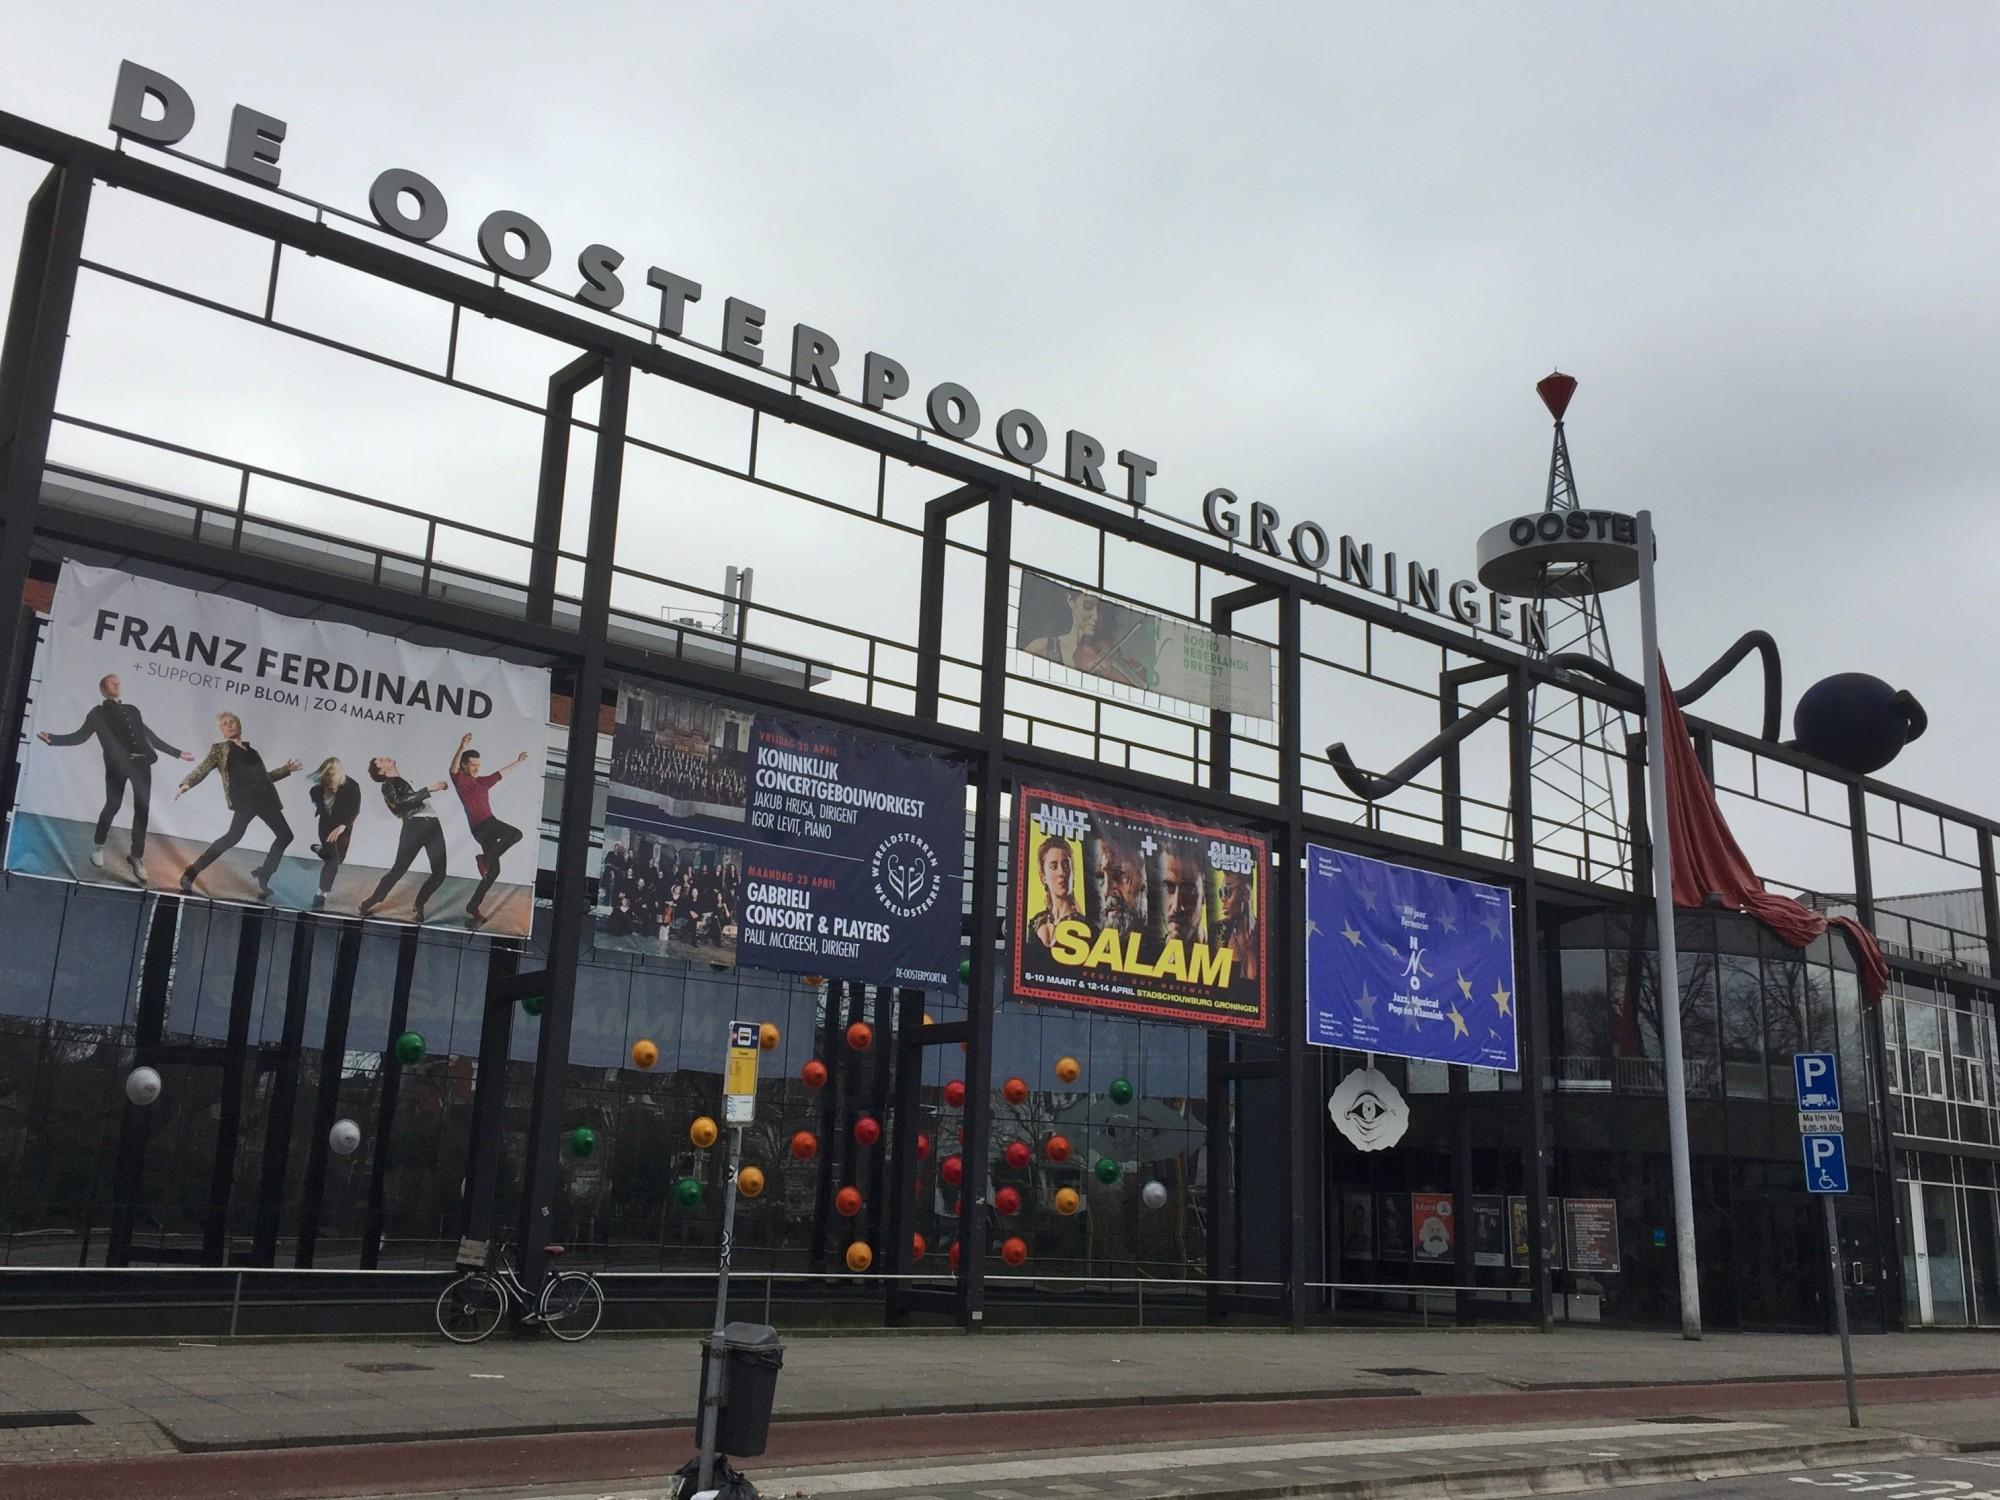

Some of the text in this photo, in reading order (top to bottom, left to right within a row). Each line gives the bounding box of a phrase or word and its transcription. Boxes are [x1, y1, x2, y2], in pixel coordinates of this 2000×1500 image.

[108, 58, 1550, 651] DE OOSTERPOORT GRONINGEN
[1184, 632, 1219, 652] NOORD
[92, 609, 493, 720] FRANZ FERDINAND
[1184, 647, 1249, 672] NEDERLANDS
[1184, 659, 1223, 677] ORKEST
[147, 661, 222, 690] SUPPORT
[224, 680, 250, 694] PIP
[254, 686, 299, 707] BLOM
[313, 697, 337, 713] ZO
[340, 702, 349, 716] 4
[349, 703, 406, 725] MAART
[757, 747, 839, 781] KONINKLIJK
[813, 743, 839, 758] APRIL
[753, 791, 858, 825] JAKUB HRUSA, DIRIGENT
[755, 769, 925, 818] CONCERTGEBOUWORKEST
[751, 810, 832, 840] IGOR LEVIT, PIANO
[1033, 803, 1091, 841] NNT
[872, 833, 938, 877] WERELDSTERREN
[748, 866, 793, 882] MAANDAG
[811, 876, 836, 890] APRIL
[747, 882, 810, 910] GABRIELI
[874, 875, 941, 917] WERELDSTERREN
[746, 904, 890, 943] CONSORT & PLAYERS
[744, 927, 860, 959] PAUL MCCREESH, DIRIGENT
[1050, 919, 1234, 988] SALAM
[1025, 971, 1259, 1014] 8-10 MAART & 12-14 APRIL STADSCHOUWBURG GRONINGEN
[1411, 995, 1439, 1009] Musical
[1388, 1002, 1403, 1016] Pop
[1414, 1007, 1445, 1021] Klassiek
[1803, 1057, 1827, 1088] P
[1803, 1113, 1814, 1122] Ma
[1811, 1138, 1835, 1168] P
